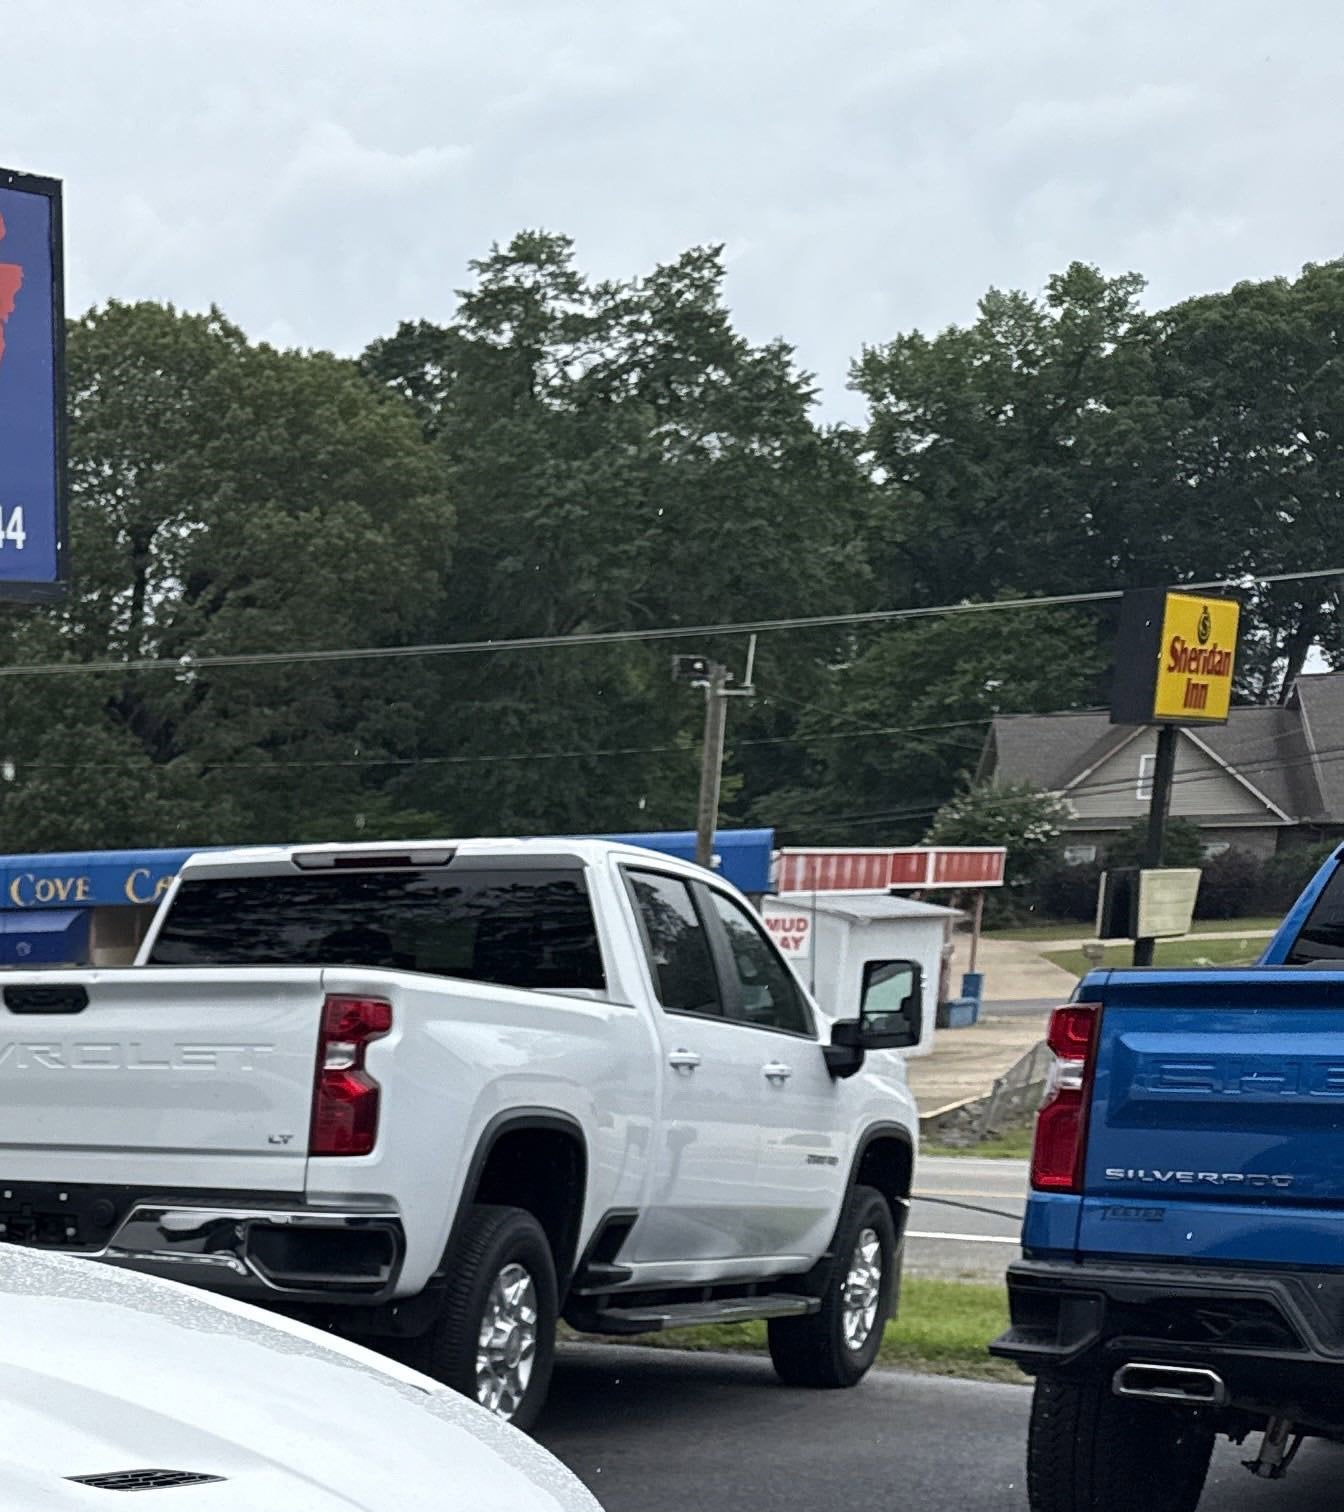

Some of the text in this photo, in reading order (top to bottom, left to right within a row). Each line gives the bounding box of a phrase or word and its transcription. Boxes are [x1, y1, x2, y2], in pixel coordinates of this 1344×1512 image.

[1167, 635, 1232, 677] Sheridan
[1183, 678, 1209, 710] Inn
[780, 936, 805, 951] AY
[268, 1134, 294, 1145] LT
[1104, 1167, 1295, 1188] SILVERADO
